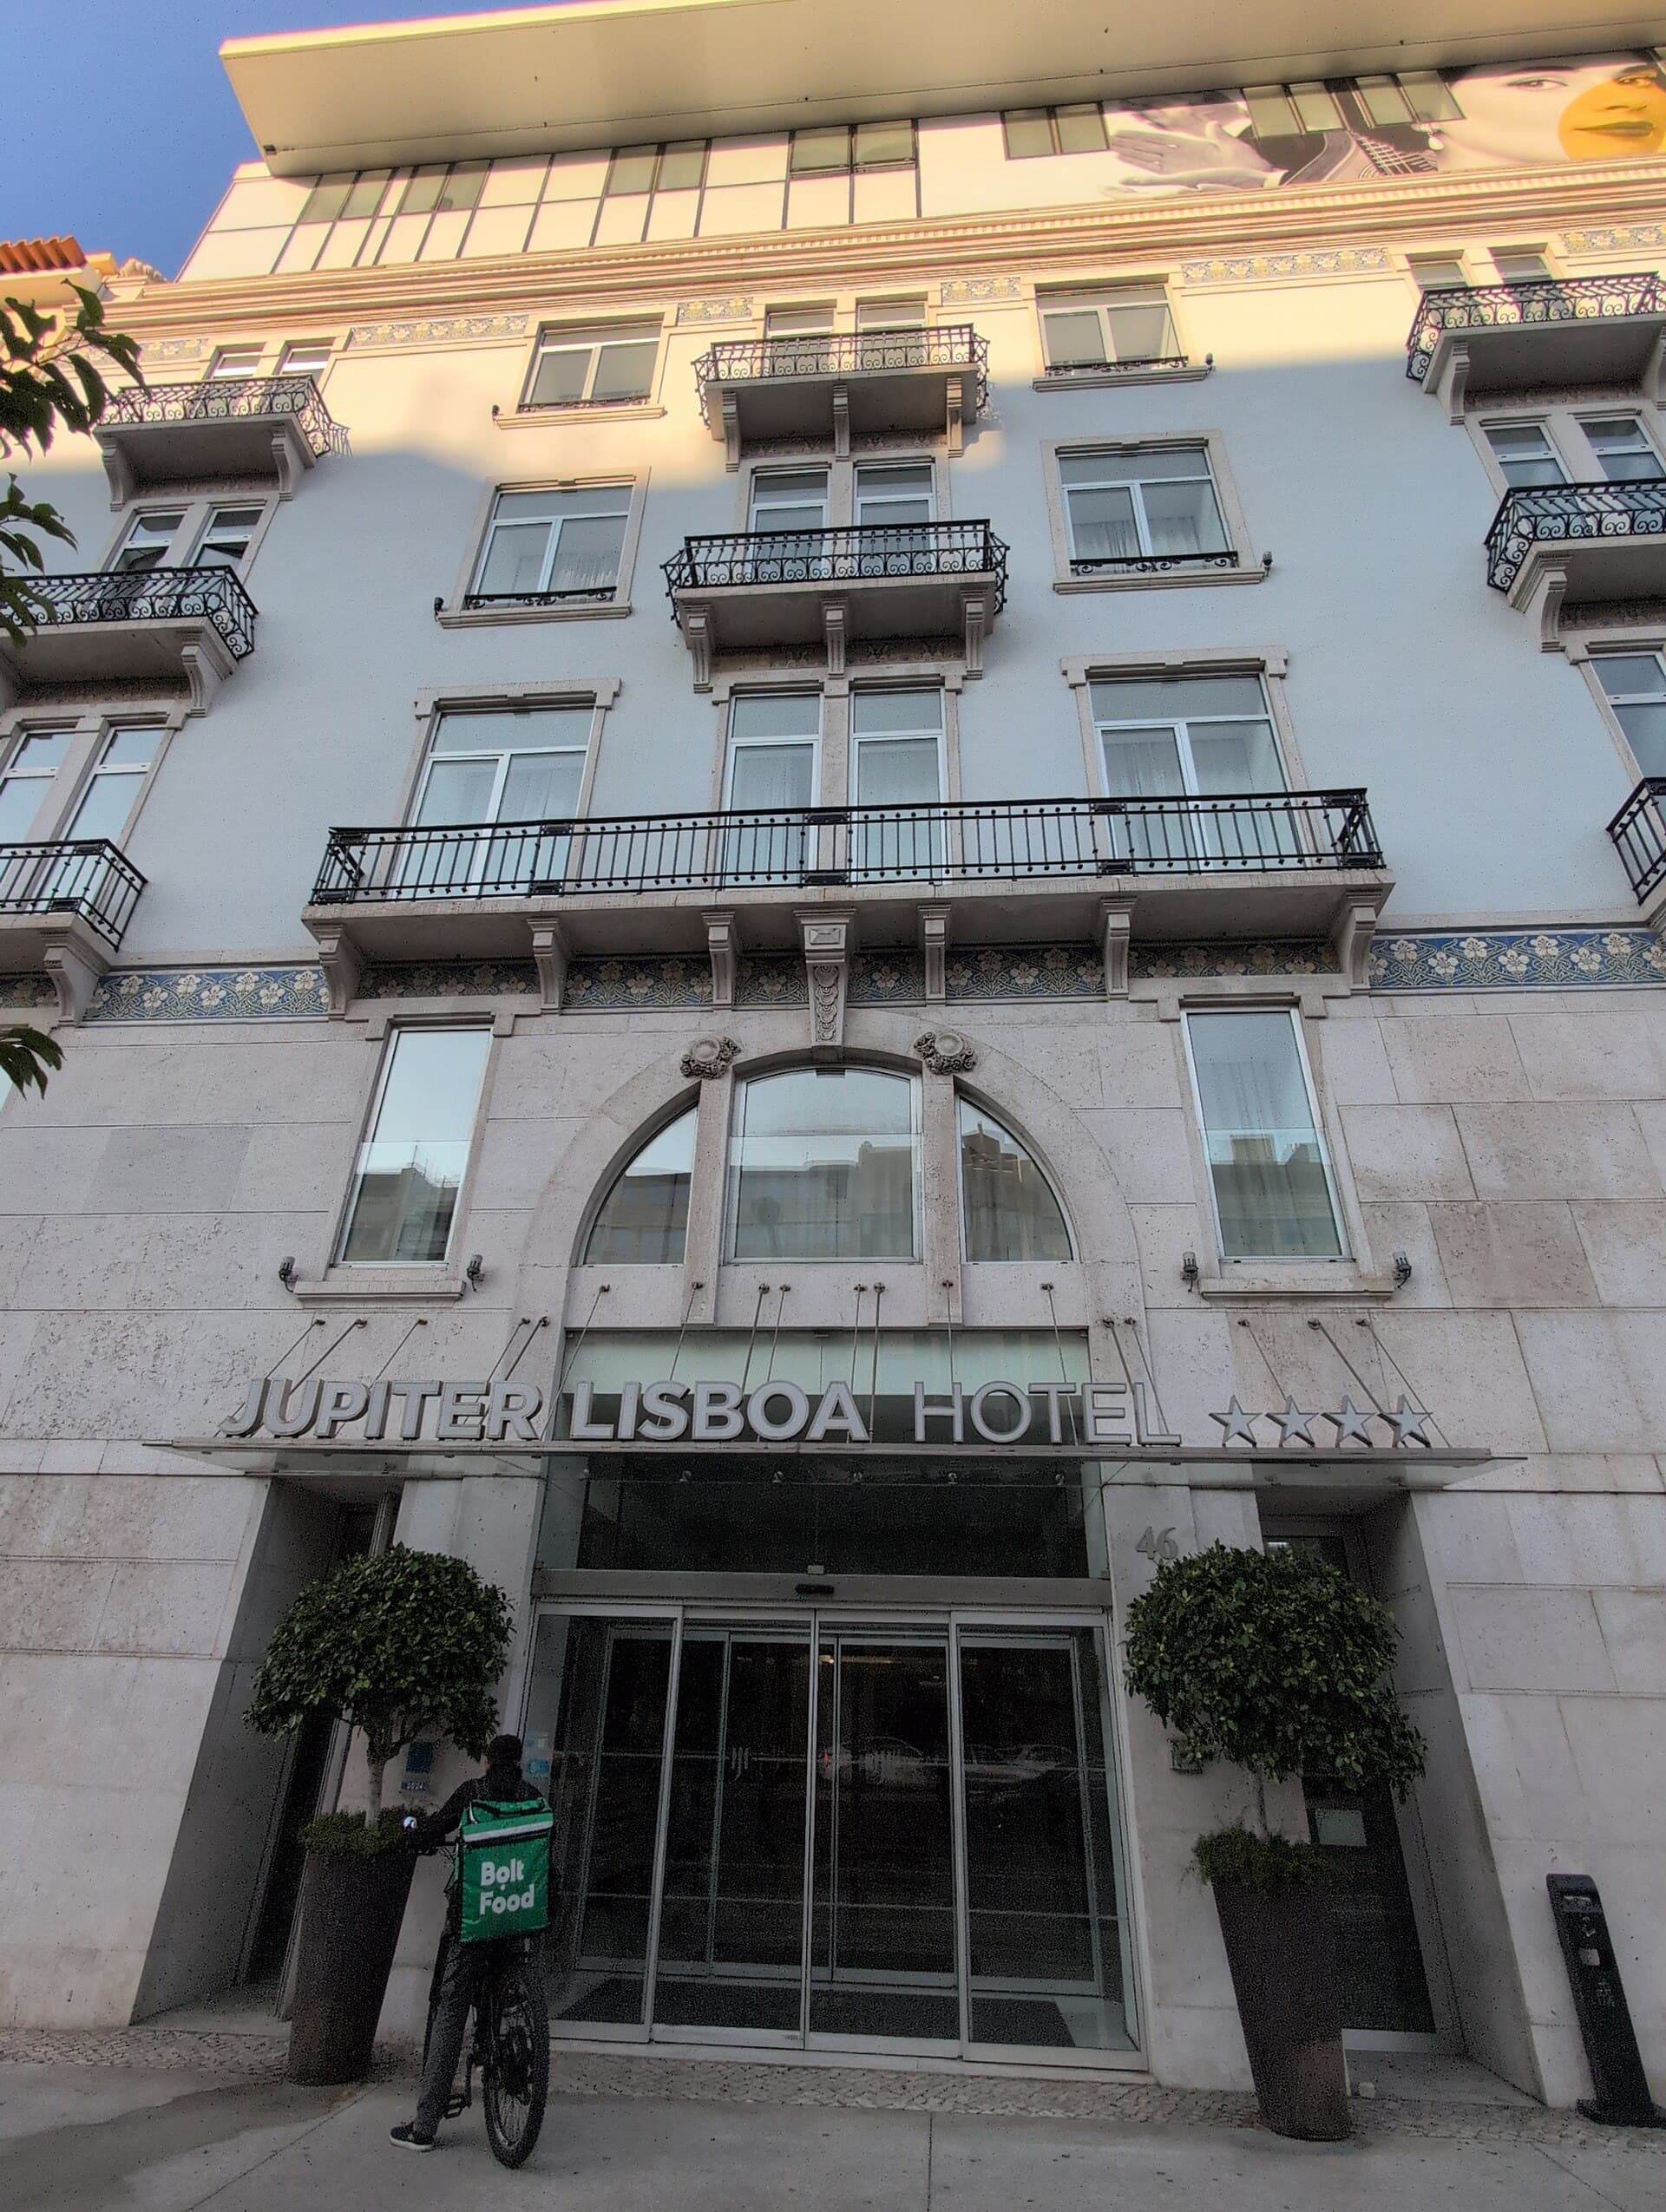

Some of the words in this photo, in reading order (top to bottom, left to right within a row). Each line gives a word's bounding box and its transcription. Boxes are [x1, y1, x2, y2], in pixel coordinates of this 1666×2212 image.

[221, 1378, 544, 1440] JUPITER
[570, 1380, 870, 1441] LISBOA
[914, 1380, 1182, 1446] HOTEL
[1135, 1526, 1179, 1560] 46
[480, 1858, 524, 1888] Bolt
[479, 1883, 535, 1915] Food
